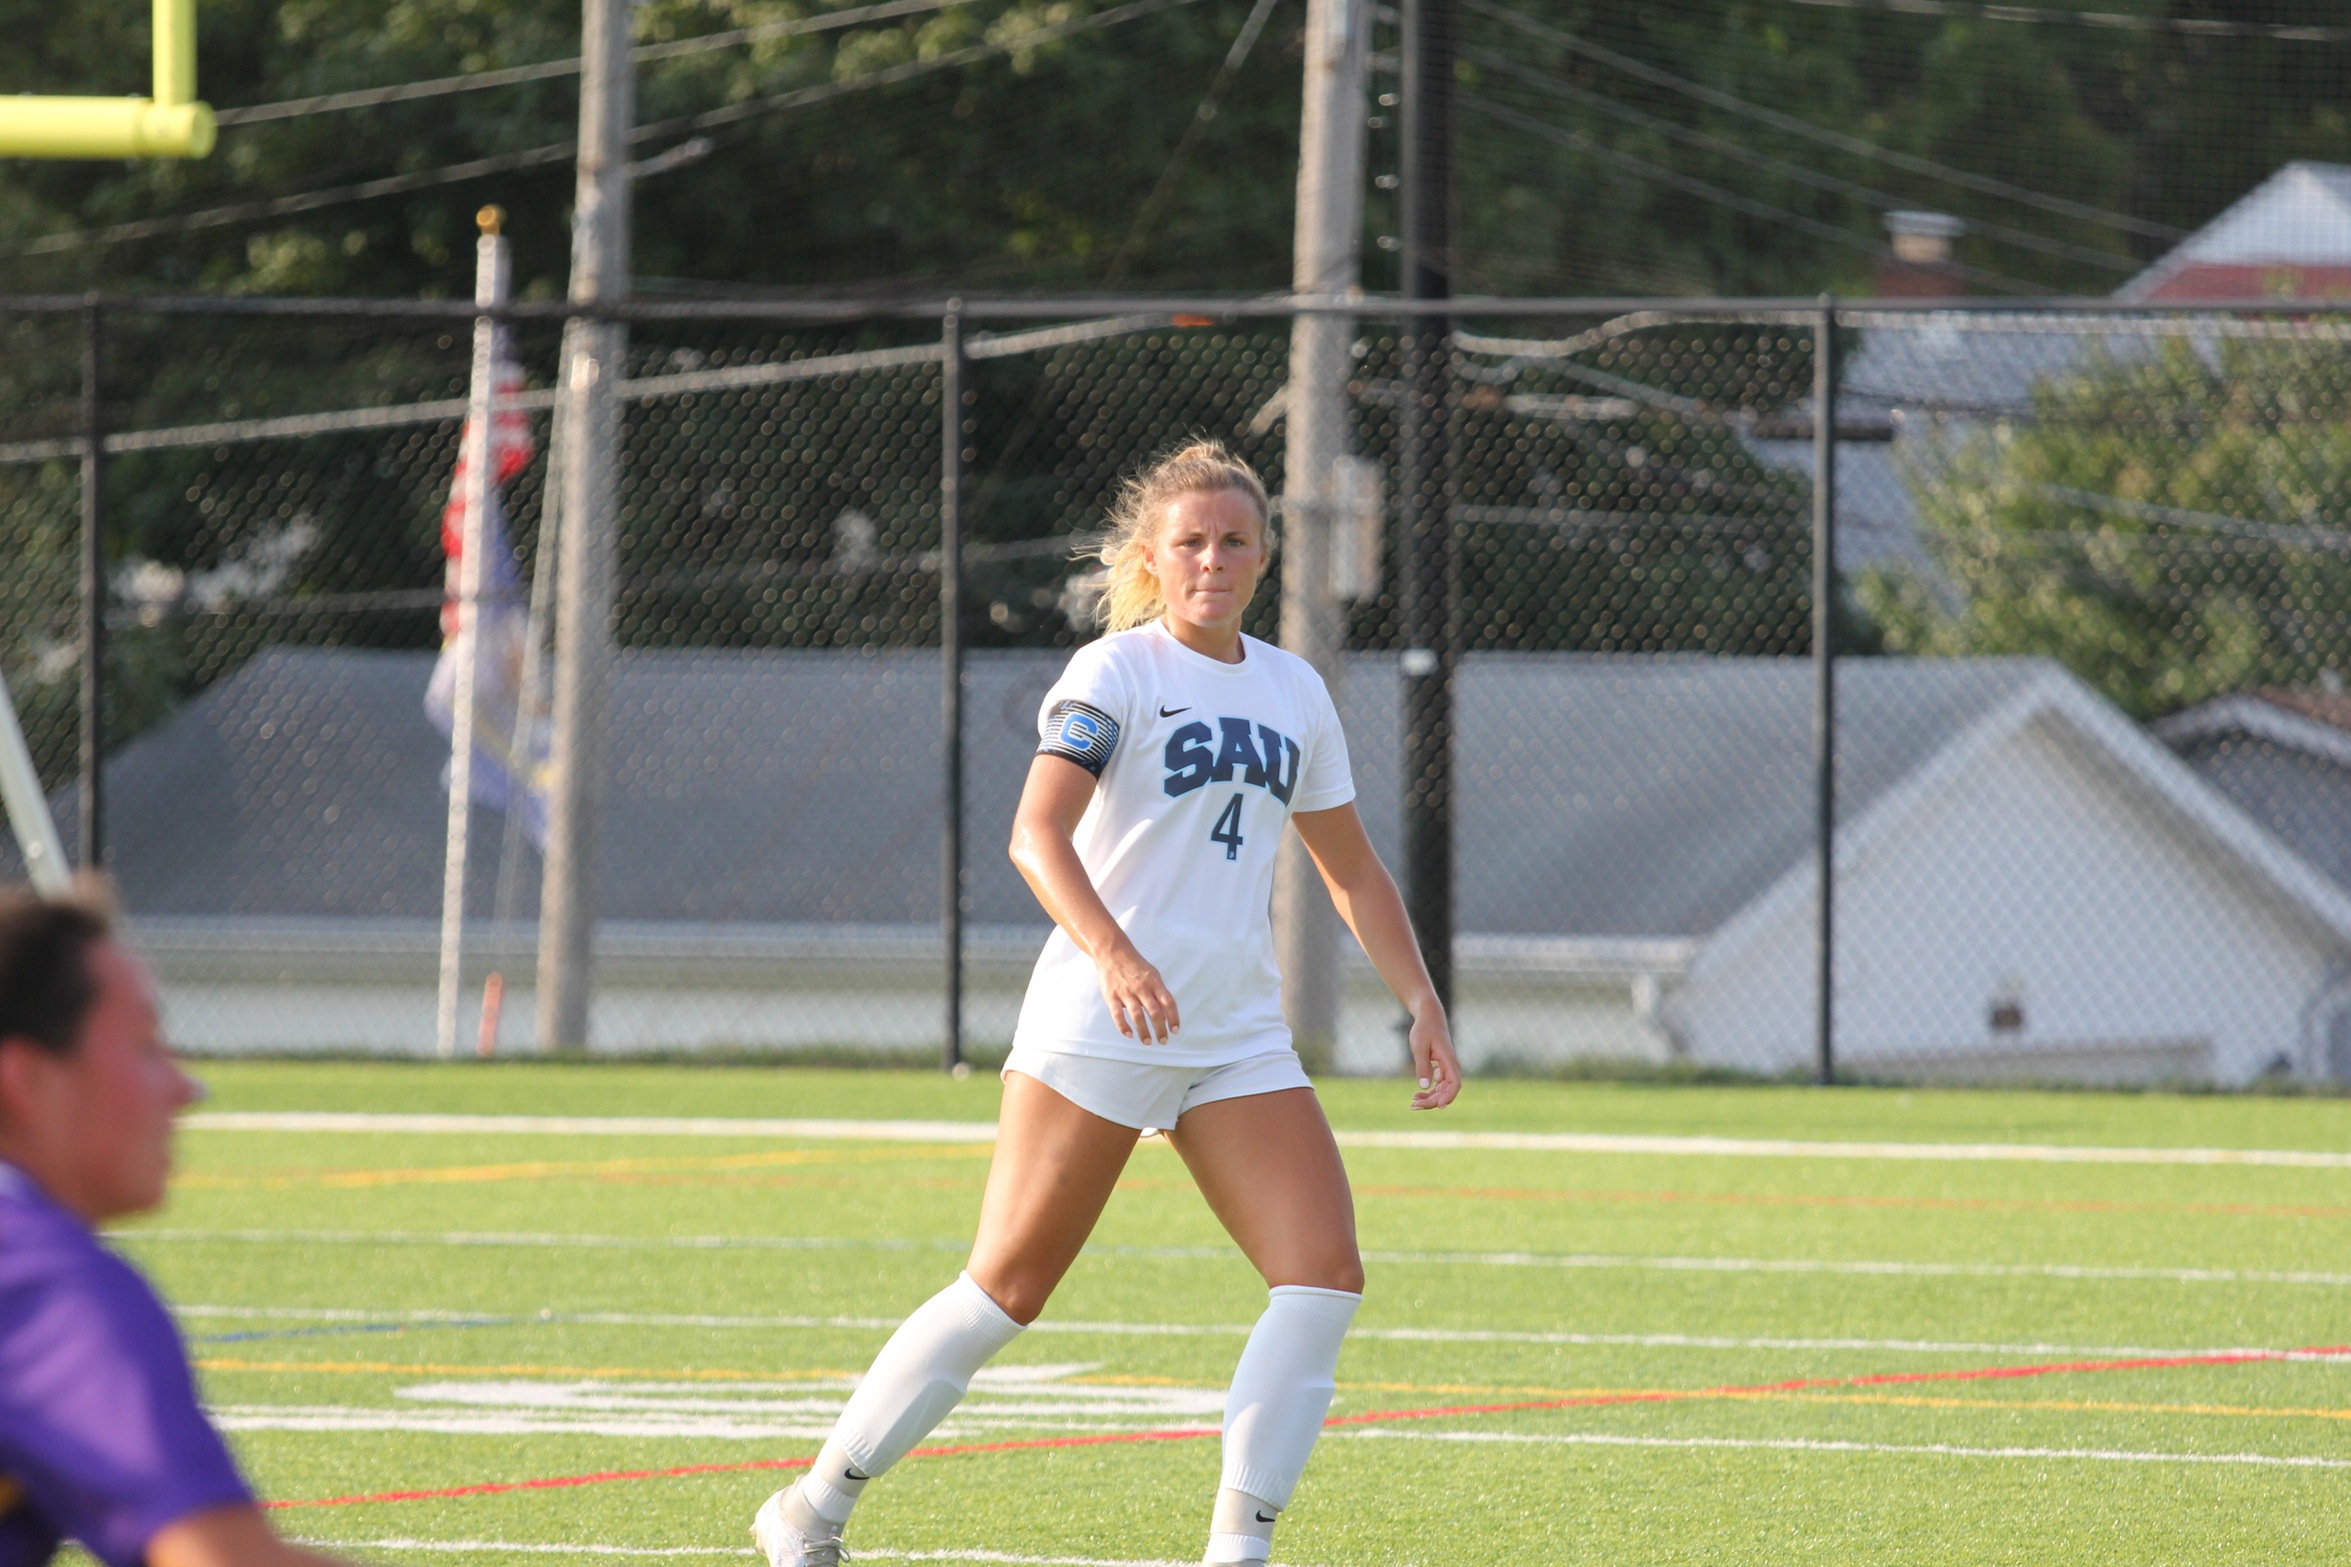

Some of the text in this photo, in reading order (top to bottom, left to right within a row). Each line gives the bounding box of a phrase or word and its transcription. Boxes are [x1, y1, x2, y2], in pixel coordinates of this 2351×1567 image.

[1060, 713, 1098, 751] C
[1164, 717, 1300, 807] SAU
[1211, 793, 1243, 861] 4
